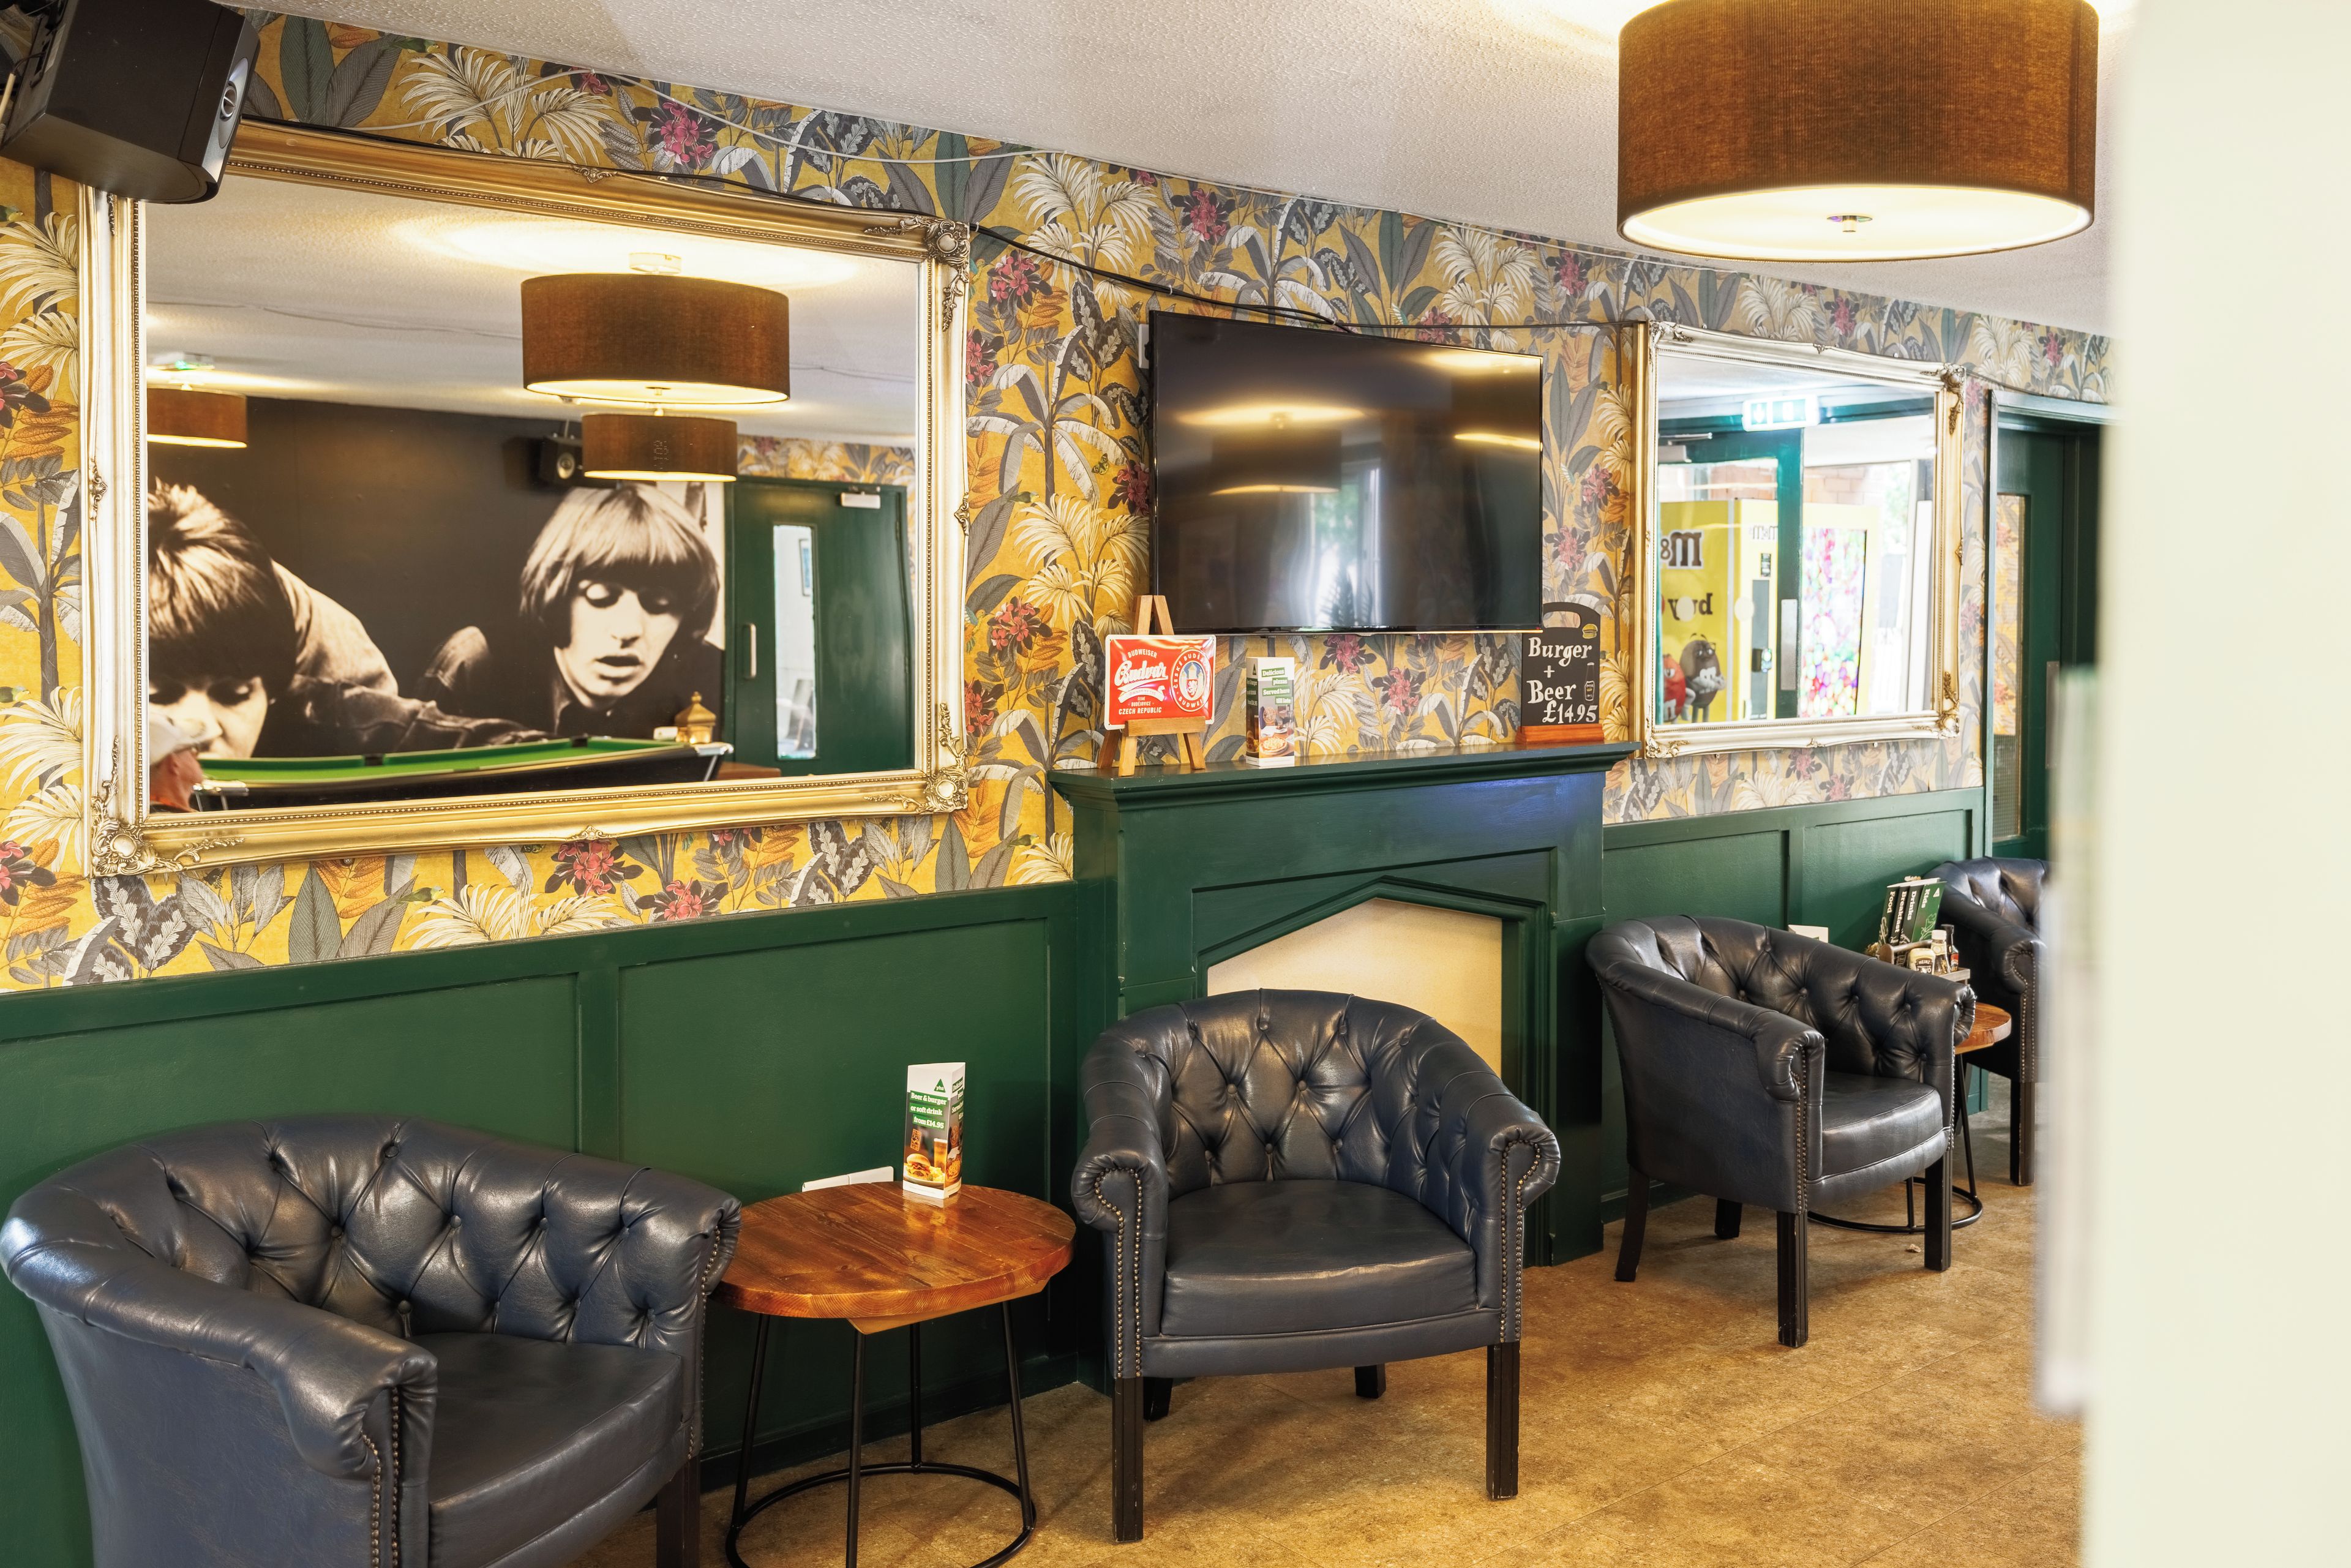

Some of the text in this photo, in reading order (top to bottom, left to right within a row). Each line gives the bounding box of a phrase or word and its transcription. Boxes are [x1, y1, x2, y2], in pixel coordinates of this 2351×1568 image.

[1128, 649, 1157, 659] BUDWEISER
[1528, 637, 1592, 667] Burger
[1114, 660, 1168, 686] Budvar
[1543, 666, 1555, 678] +
[1526, 680, 1577, 703] Beer
[1542, 699, 1598, 724] £14.95
[1887, 891, 1895, 913] Food
[1907, 891, 1917, 920] Drinks
[1921, 888, 1930, 908] Kids
[1895, 891, 1907, 933] Breakfast
[911, 1092, 923, 1101] Beer
[928, 1096, 947, 1105] burger
[914, 1116, 945, 1129] from £14.95
